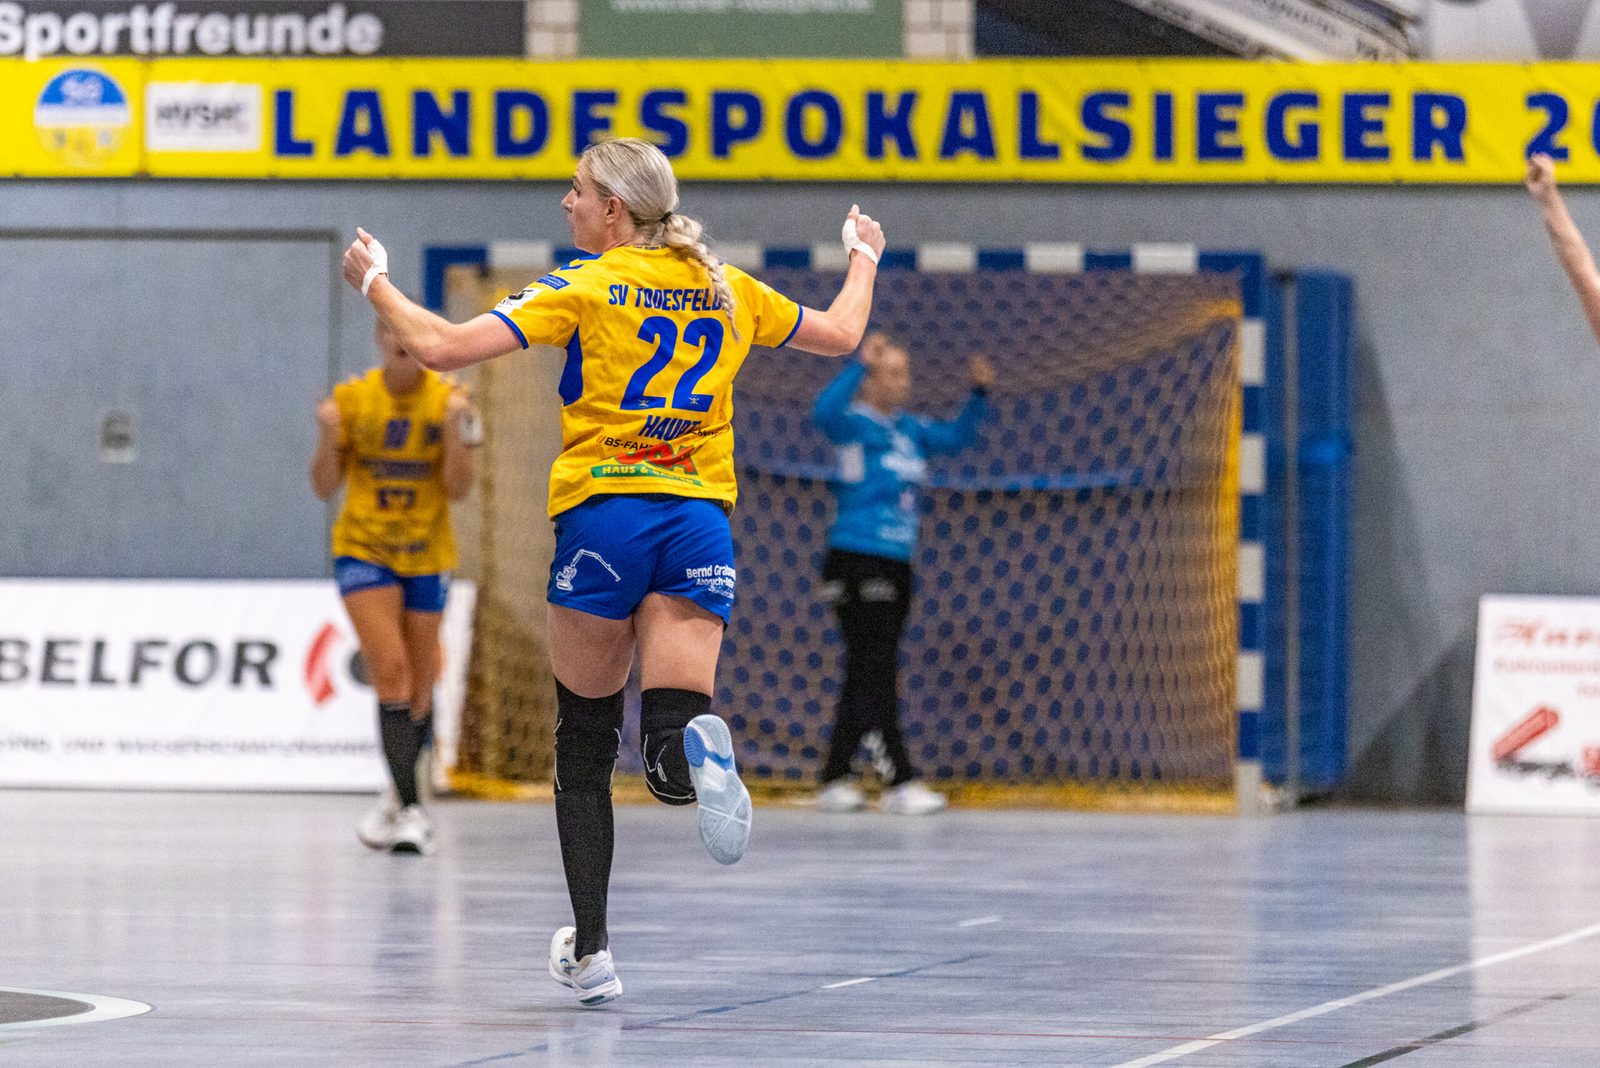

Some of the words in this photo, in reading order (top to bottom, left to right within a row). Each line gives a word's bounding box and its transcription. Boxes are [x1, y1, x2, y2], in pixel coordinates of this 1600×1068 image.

[0, 2, 382, 62] Sportfreunde
[273, 89, 1467, 161] LANDESPOKALSIEGER
[1525, 93, 1600, 161] 2
[608, 284, 629, 306] SV
[634, 287, 725, 312] TODESFELD
[620, 316, 724, 412] 22
[602, 465, 636, 474] HAUS
[686, 564, 713, 579] Bernd
[0, 638, 279, 688] BELFOR
